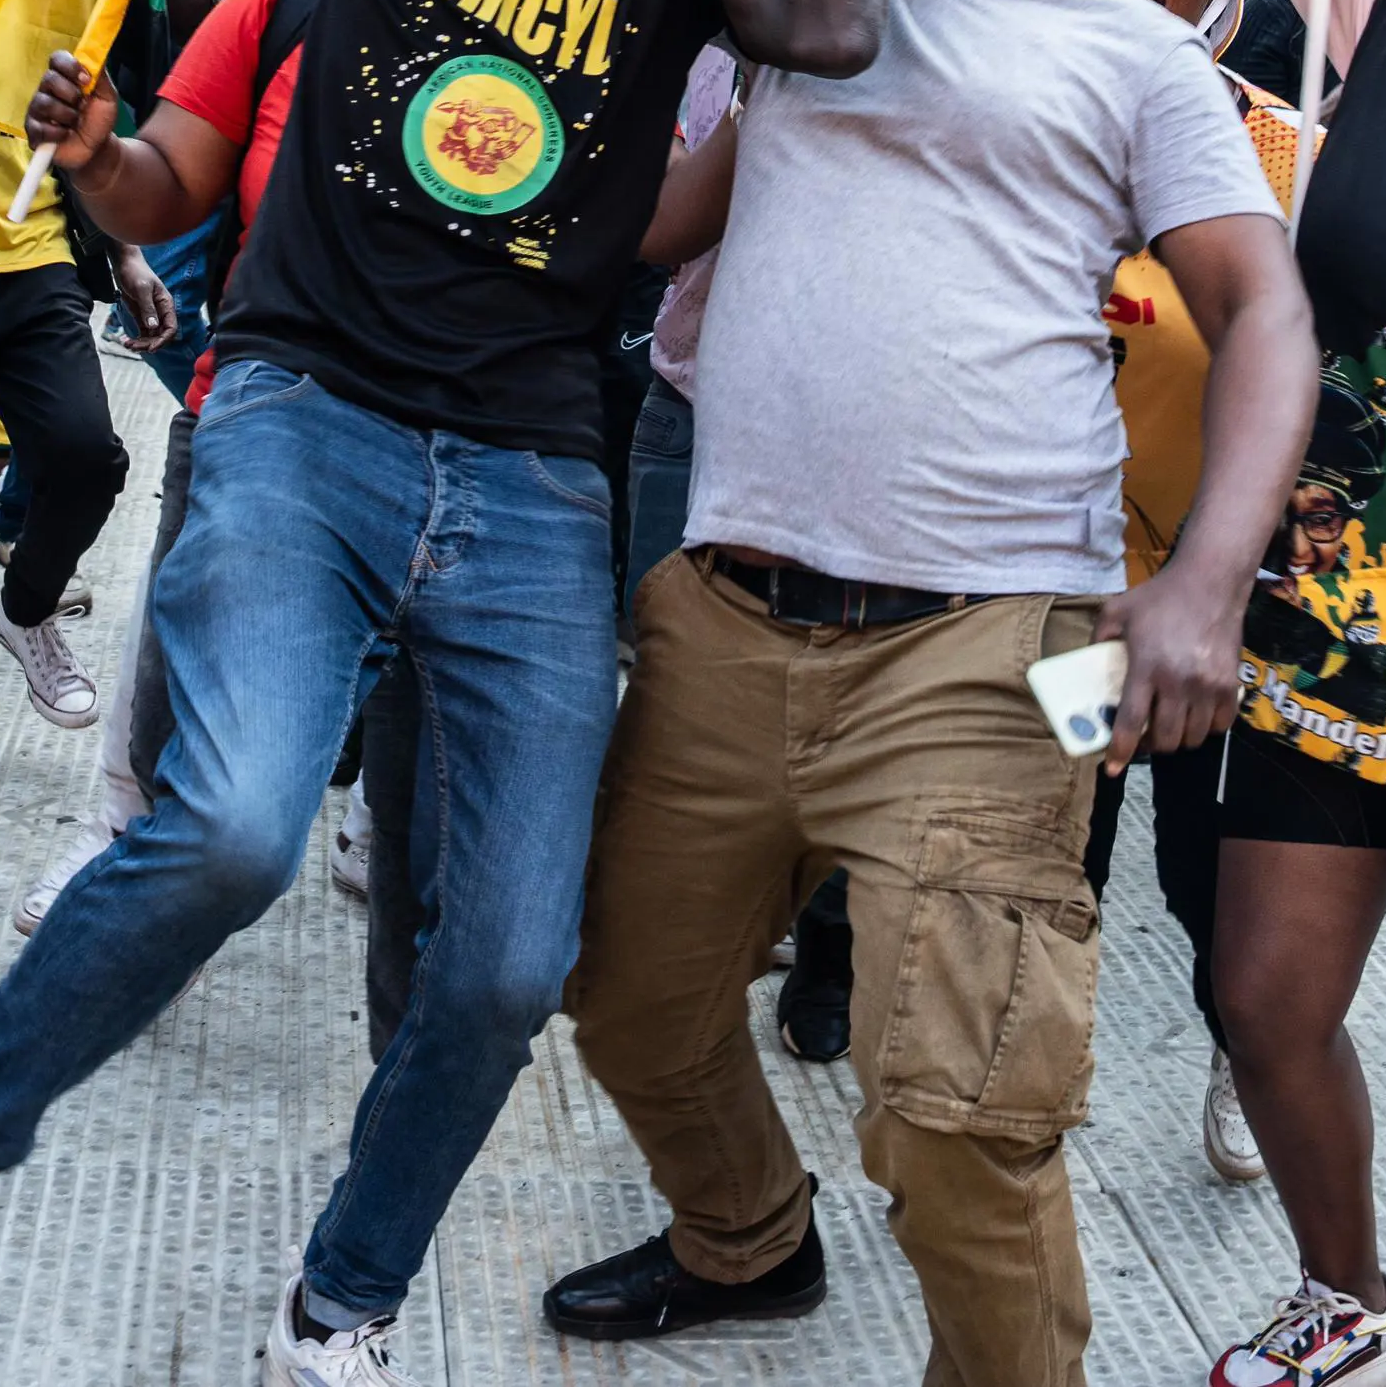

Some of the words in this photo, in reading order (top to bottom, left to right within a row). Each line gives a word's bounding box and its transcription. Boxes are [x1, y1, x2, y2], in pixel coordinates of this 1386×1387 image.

[478, 59, 537, 96] NATIONAL
[415, 159, 447, 194] YOUTH
[446, 186, 494, 209] LEAGUE
